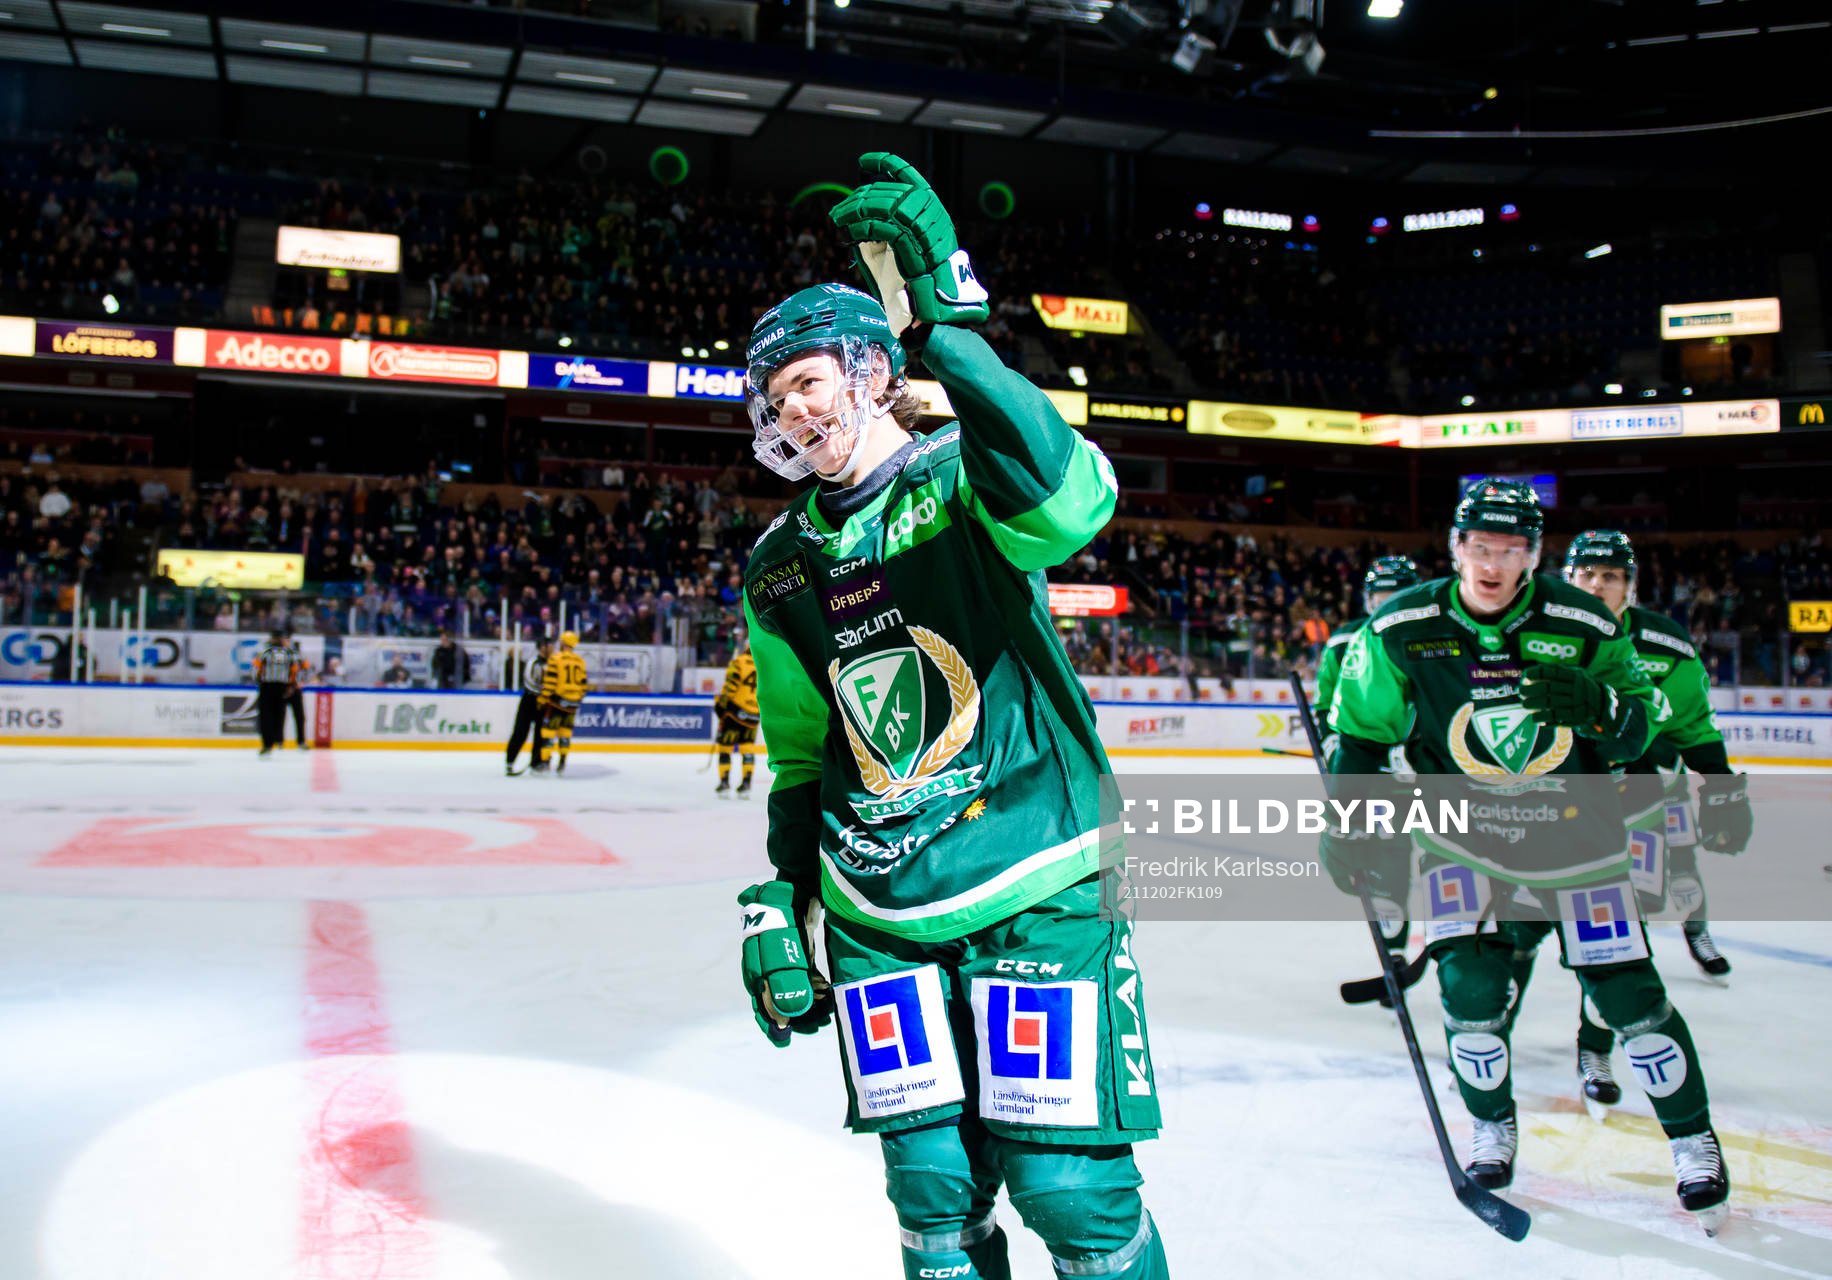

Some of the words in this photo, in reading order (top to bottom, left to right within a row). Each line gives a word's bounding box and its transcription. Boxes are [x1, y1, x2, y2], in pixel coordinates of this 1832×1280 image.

[216, 336, 331, 371] Adecco
[750, 327, 786, 359] KEWAB
[886, 497, 938, 543] coop
[829, 557, 867, 578] CCM
[1526, 639, 1578, 660] coop
[374, 704, 437, 735] LBC
[438, 720, 491, 735] frakt
[602, 706, 703, 730] Matthiessen
[871, 777, 956, 815] KARLSTAD
[996, 959, 1064, 976] CCM
[774, 989, 808, 1001] CCM
[864, 1077, 938, 1099] Länsförsäkringar
[991, 1089, 1073, 1107] Länsförsäkringar
[866, 1094, 907, 1110] Värmland
[992, 1101, 1036, 1116] Värmland
[919, 1262, 971, 1279] CCM
